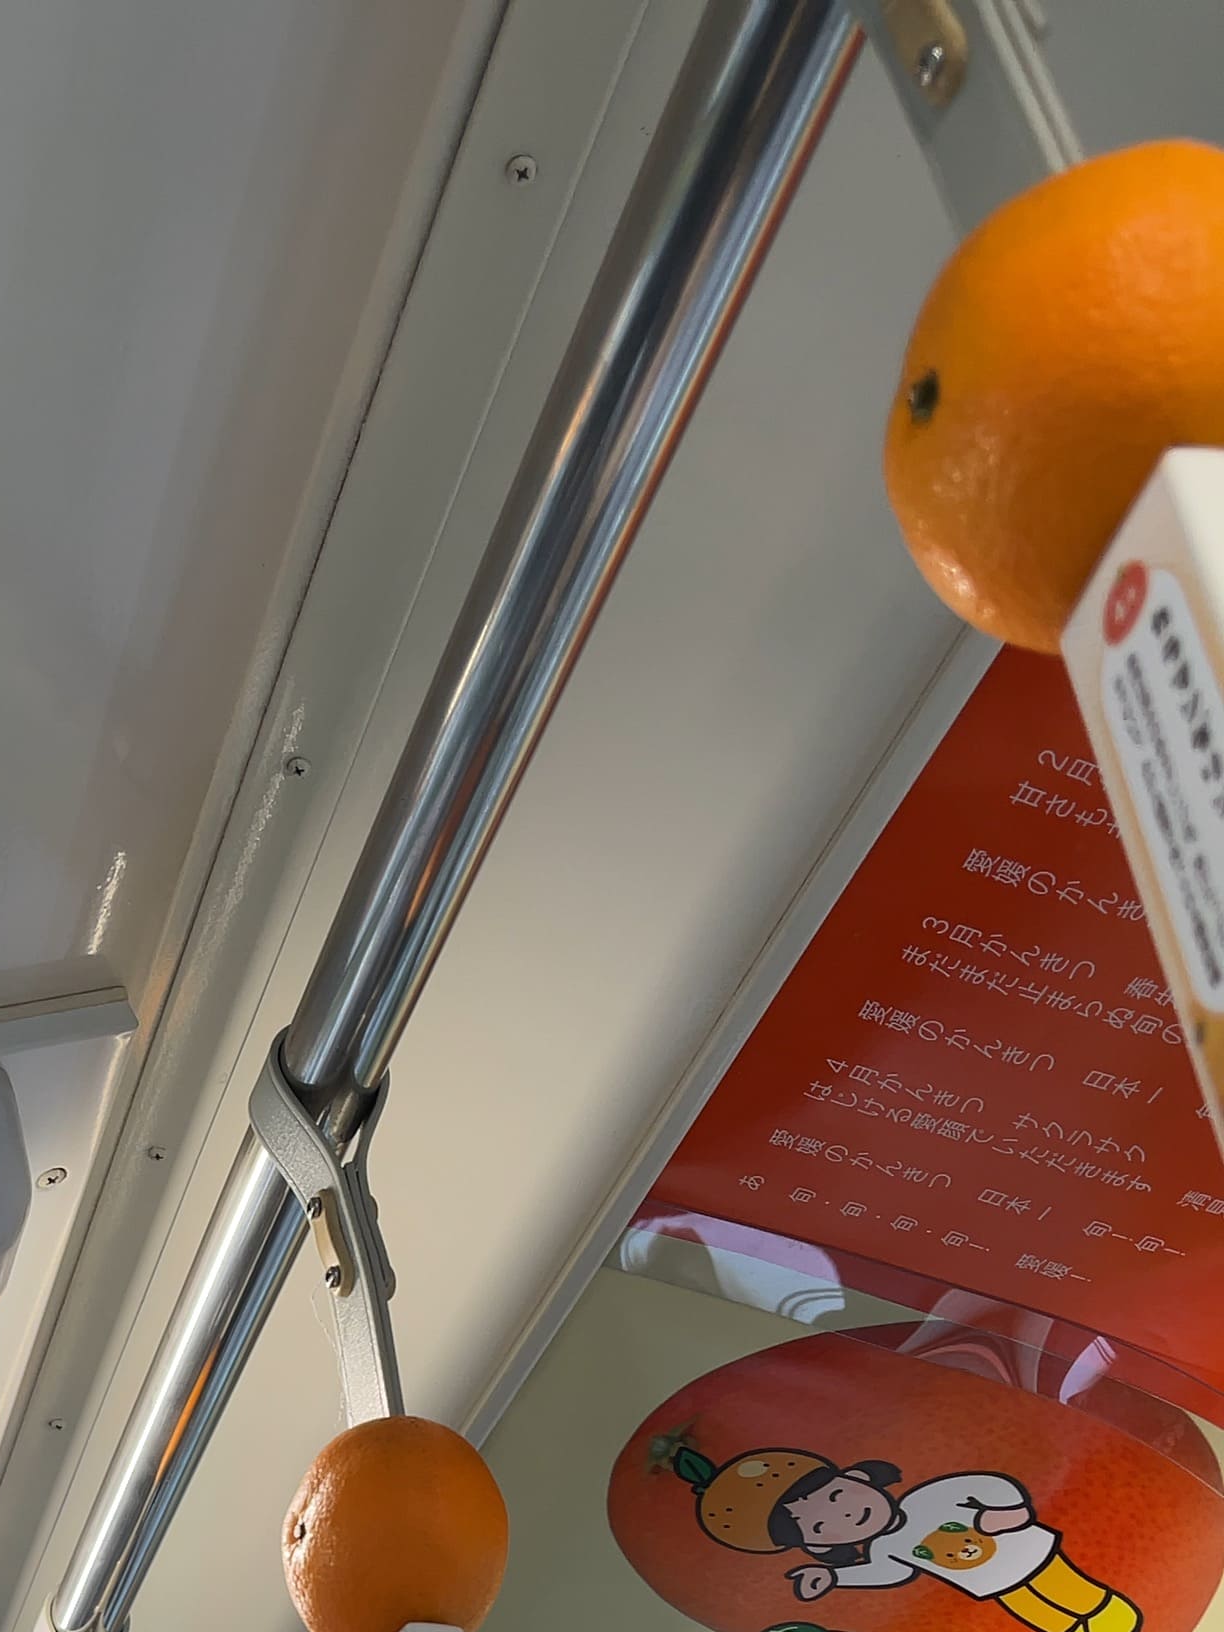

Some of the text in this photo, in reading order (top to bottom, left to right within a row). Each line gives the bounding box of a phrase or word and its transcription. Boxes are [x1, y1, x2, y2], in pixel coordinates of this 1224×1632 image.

[1038, 750, 1104, 788] 2月
[962, 847, 1148, 922] 愛媛のかんき
[901, 944, 1183, 1045] まだまだ止まらぬ旬の
[922, 916, 1097, 980] 3月かんきつ
[857, 999, 1164, 1104] 愛媛のかんきつ 日本一
[803, 1080, 1152, 1194] はじける愛顔でいただきます
[825, 1057, 1146, 1163] 4月かんきつ サクラサク
[738, 1174, 766, 1191] あ
[1015, 1252, 1093, 1283] 愛媛!
[768, 1127, 1187, 1257] 愛媛のかんきつ 日本一 旬!旬!
